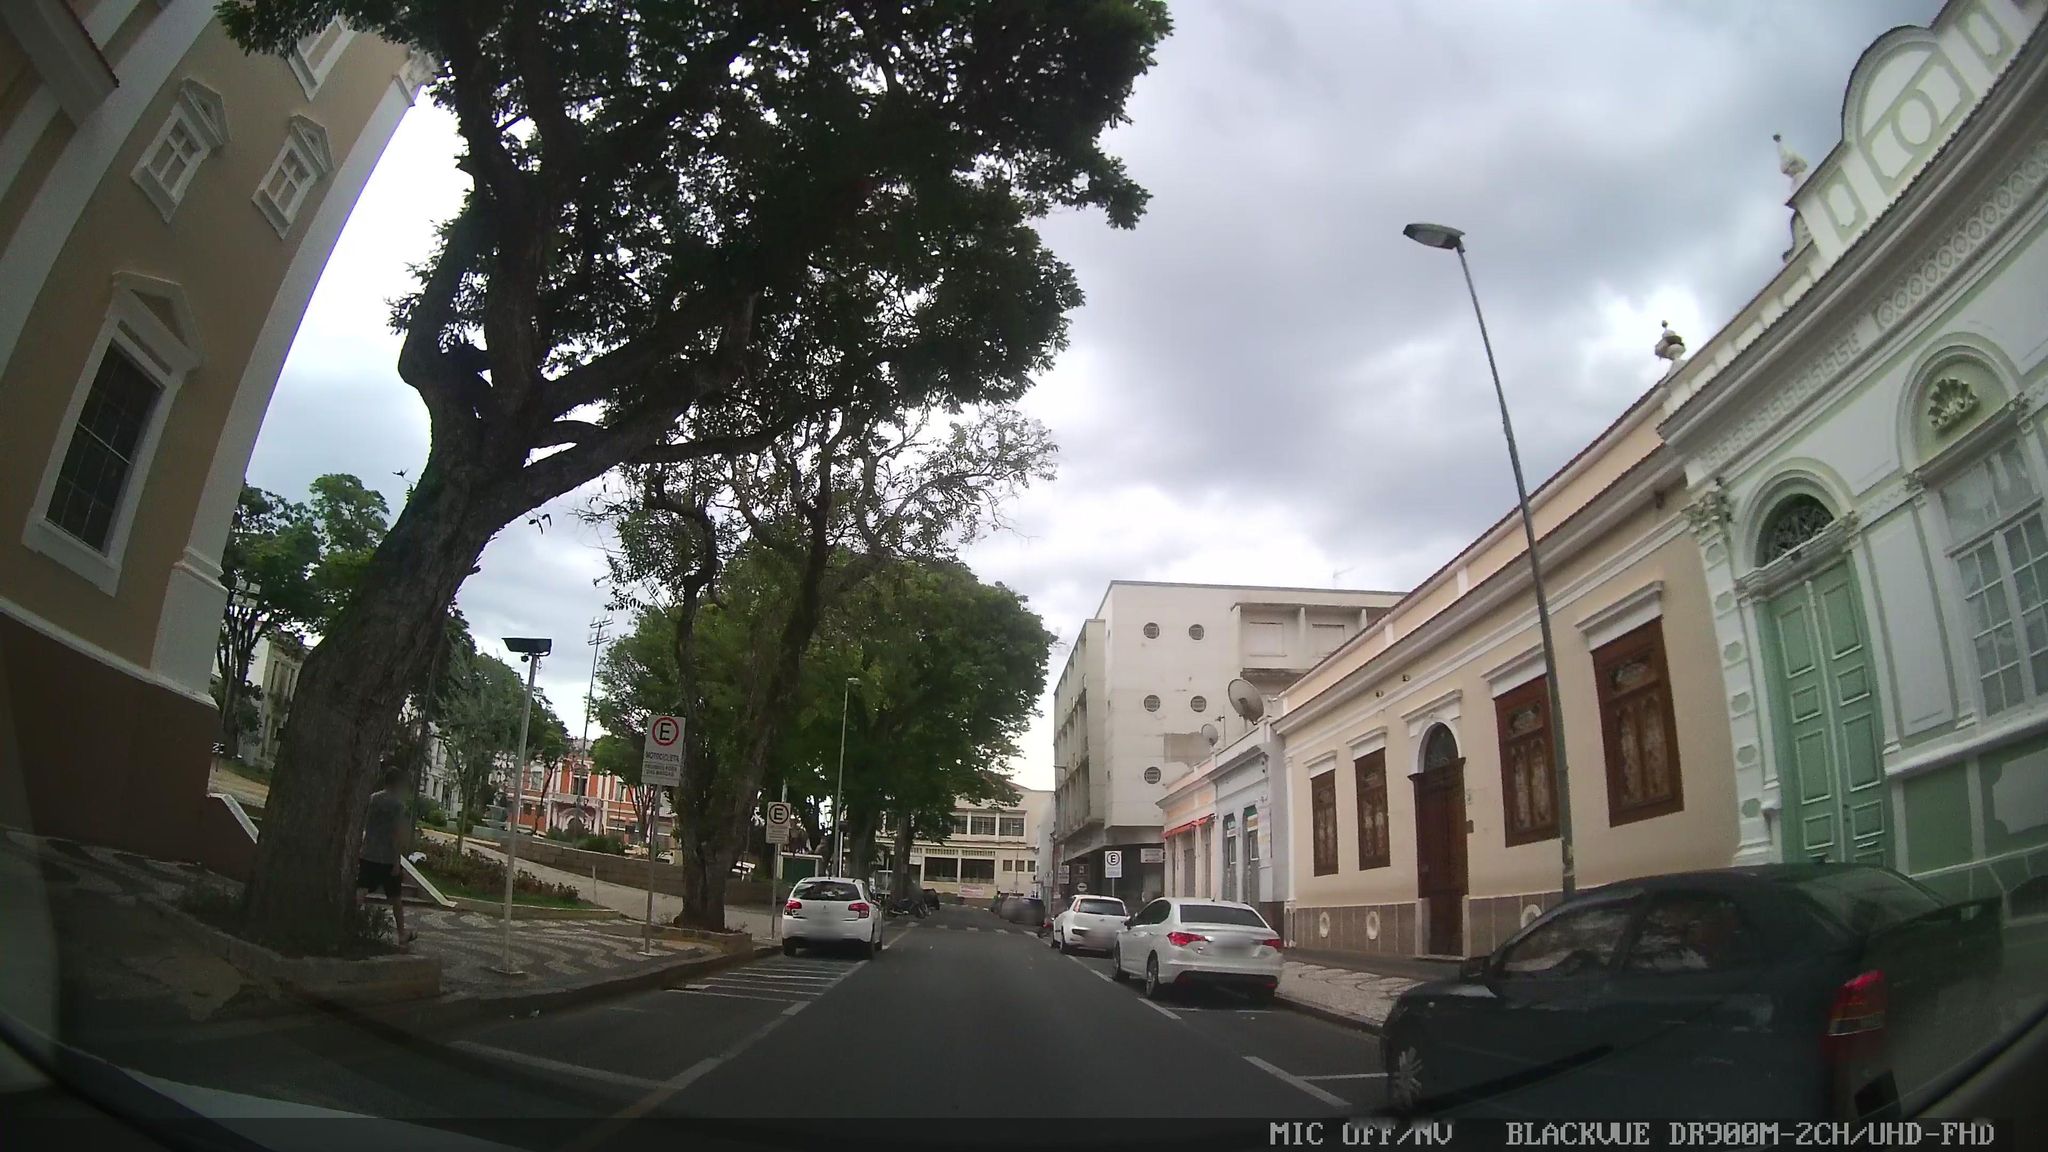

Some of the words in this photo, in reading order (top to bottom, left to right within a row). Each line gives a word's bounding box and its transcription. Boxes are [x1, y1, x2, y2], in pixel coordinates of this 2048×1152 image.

[659, 723, 672, 740] E
[774, 808, 783, 820] E
[1110, 854, 1117, 863] E
